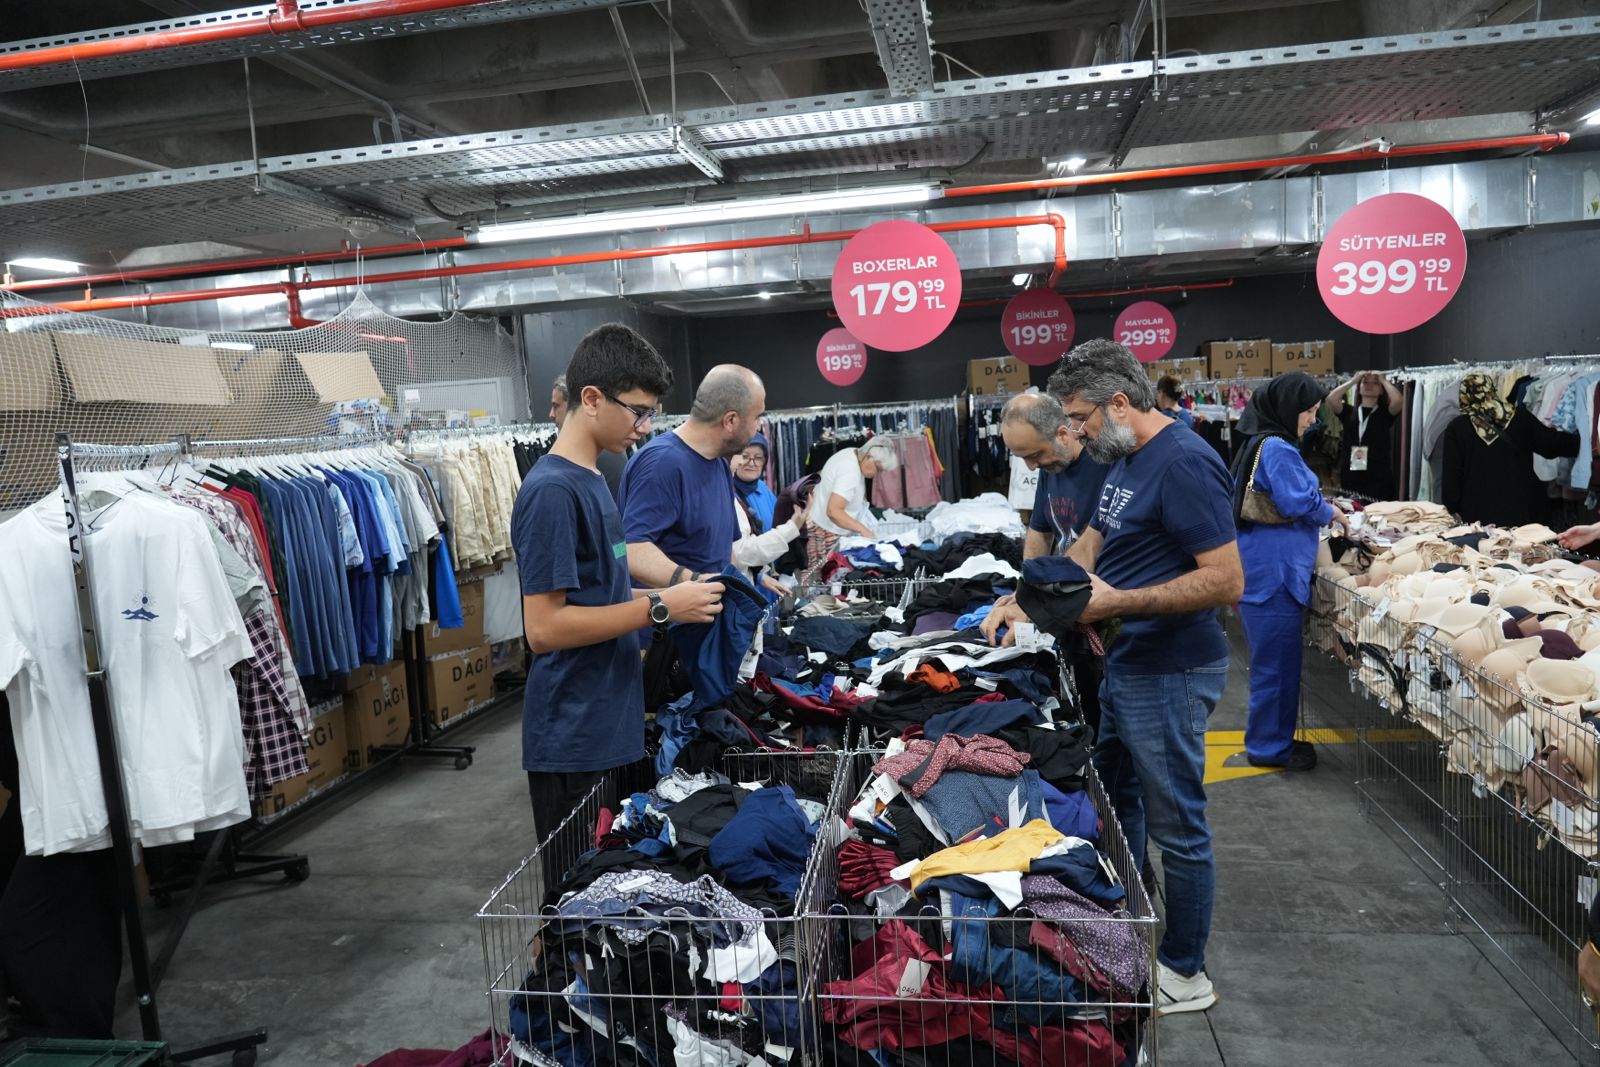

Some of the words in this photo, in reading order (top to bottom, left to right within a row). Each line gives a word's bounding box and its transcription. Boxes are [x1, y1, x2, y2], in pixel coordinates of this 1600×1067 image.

[1340, 232, 1446, 252] SÜTYENLER
[852, 256, 938, 274] BOXERLAR
[1330, 258, 1417, 296] 399
[1424, 277, 1448, 291] TL
[849, 280, 918, 316] 179
[924, 296, 946, 309] TL
[1125, 318, 1163, 326] MAYOLAR
[1010, 324, 1052, 346] 199
[1055, 333, 1068, 342] TL
[1120, 329, 1157, 347] 299
[823, 354, 852, 371] 199
